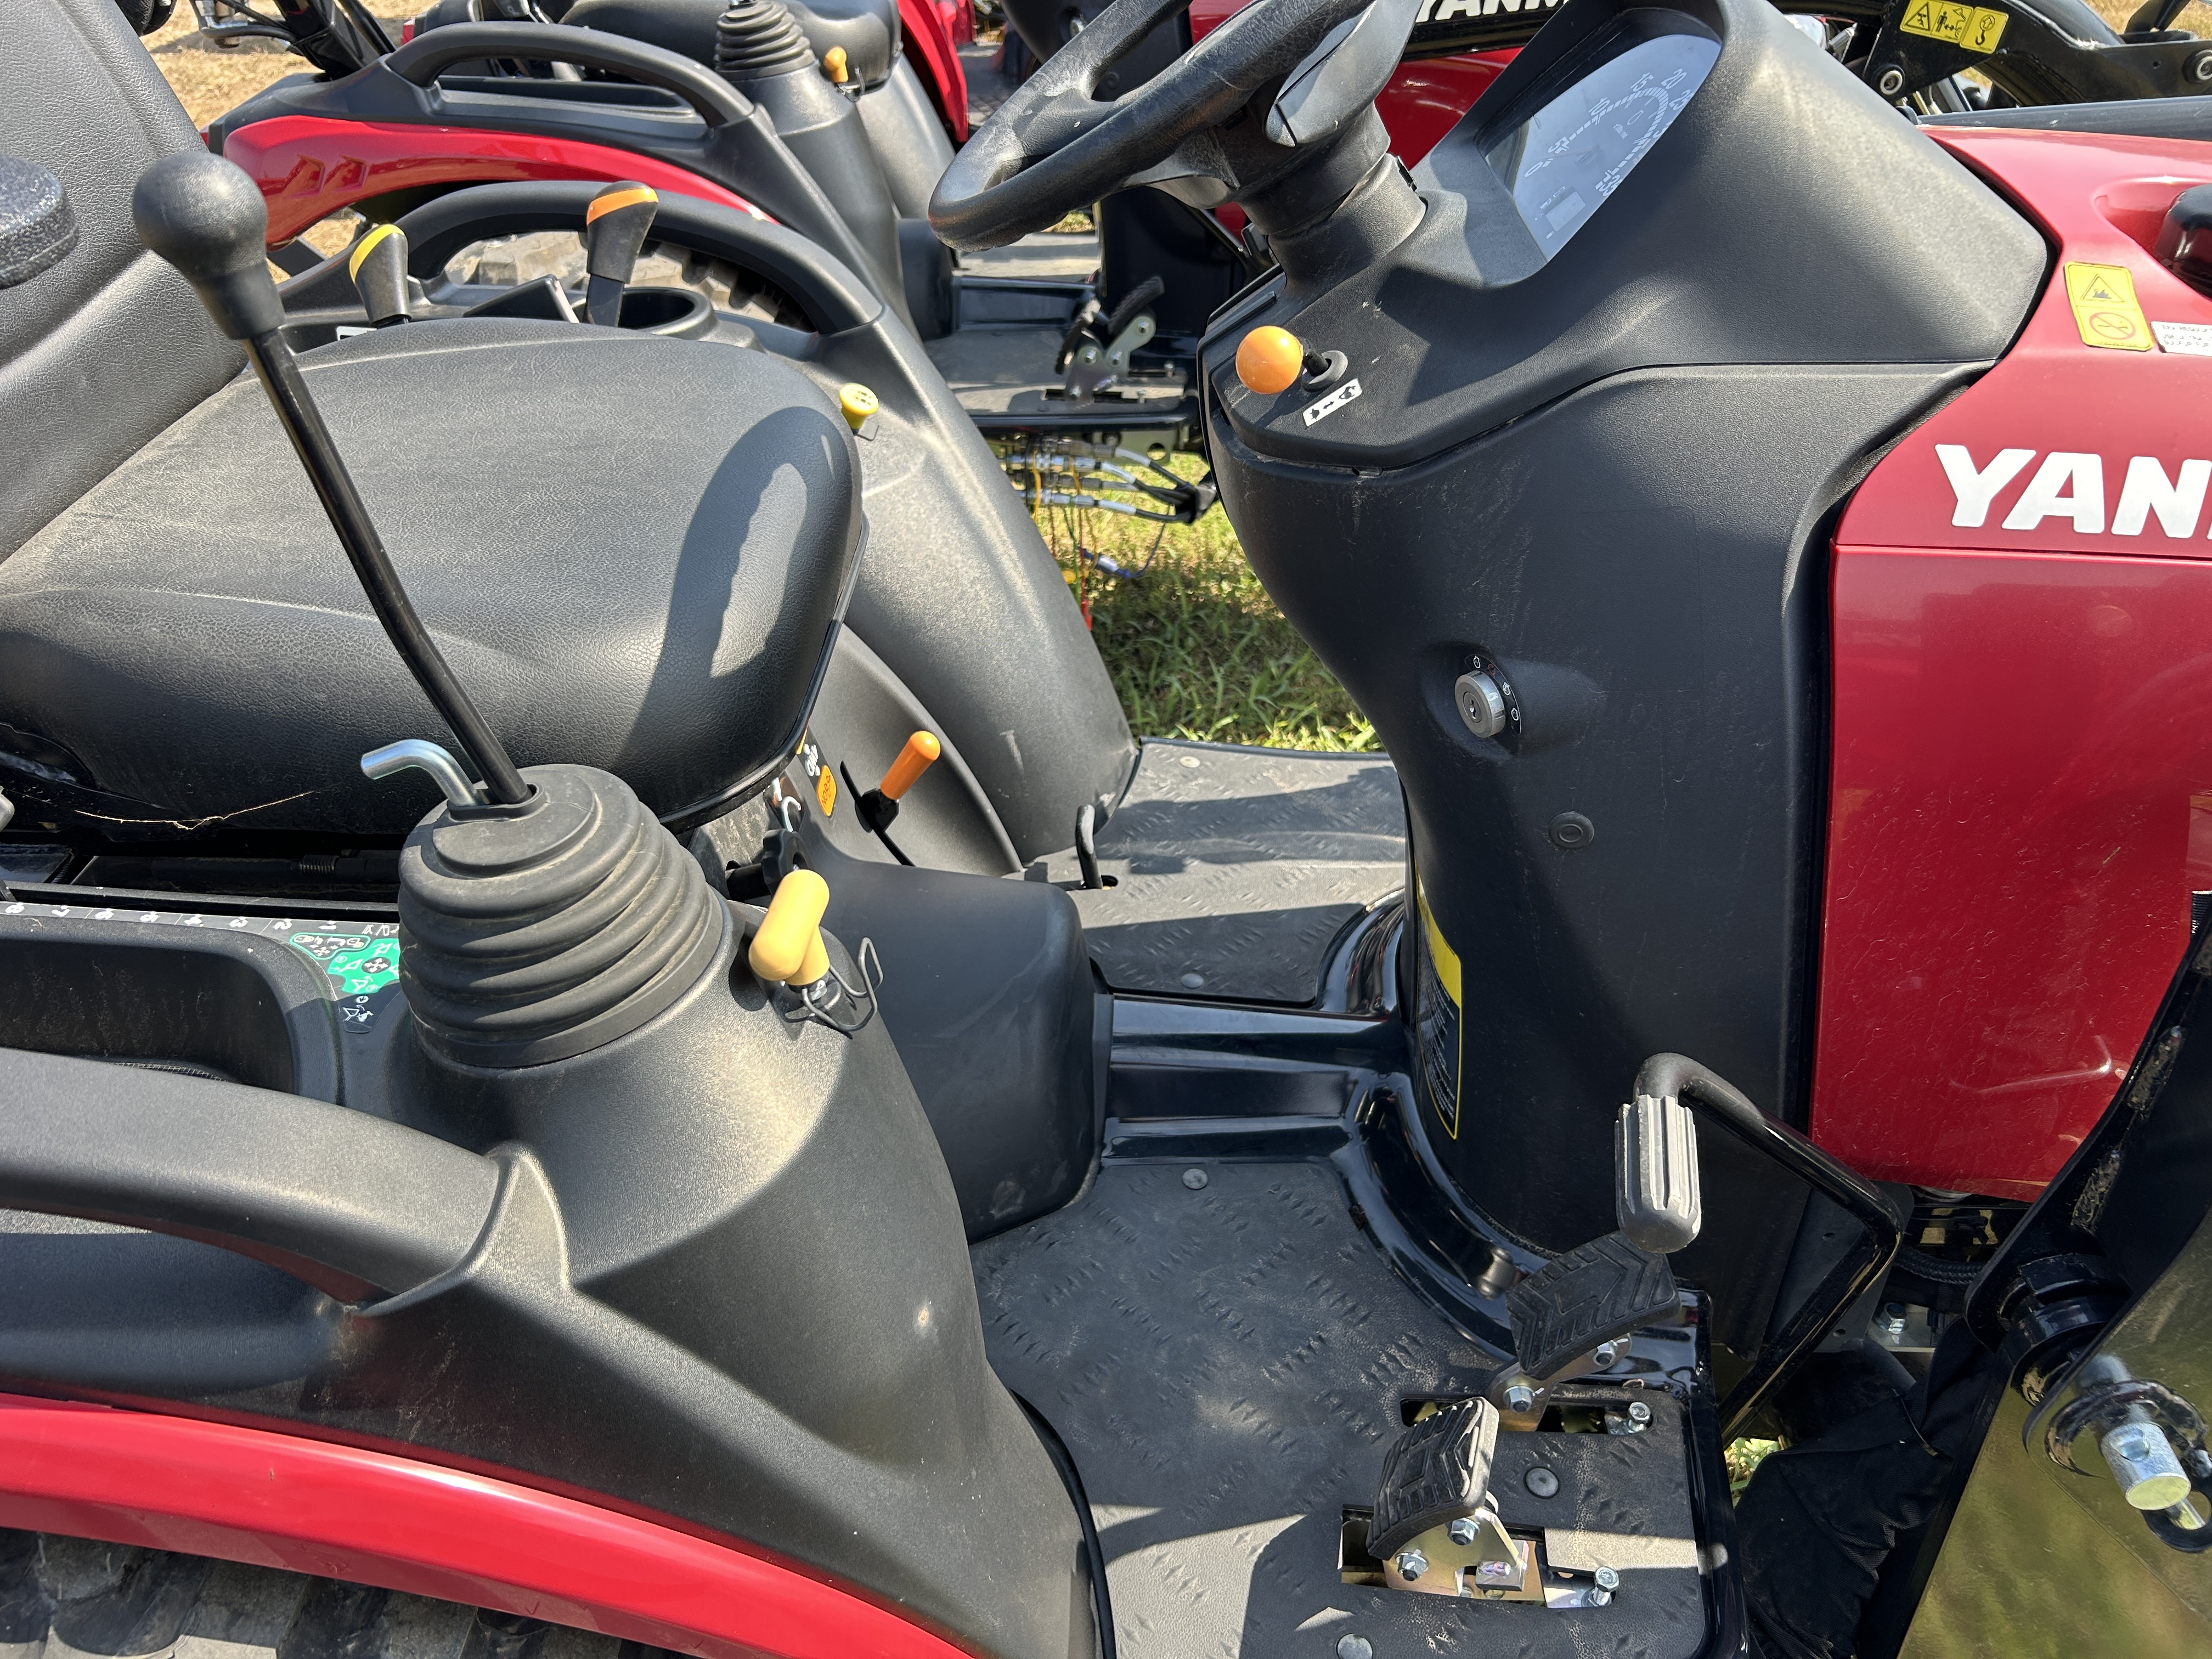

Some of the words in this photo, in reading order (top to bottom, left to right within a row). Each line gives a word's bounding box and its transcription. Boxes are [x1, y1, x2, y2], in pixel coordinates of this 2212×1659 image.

[1630, 72, 1654, 92] 15
[1661, 68, 1687, 89] 20
[1589, 97, 1611, 116] 10
[1668, 89, 1694, 110] 25
[1548, 137, 1567, 153] 5
[1524, 162, 1543, 177] 0
[1599, 174, 1623, 196] 35
[1934, 444, 2212, 540] YAN
[229, 919, 248, 927] 3
[273, 921, 292, 930] 2
